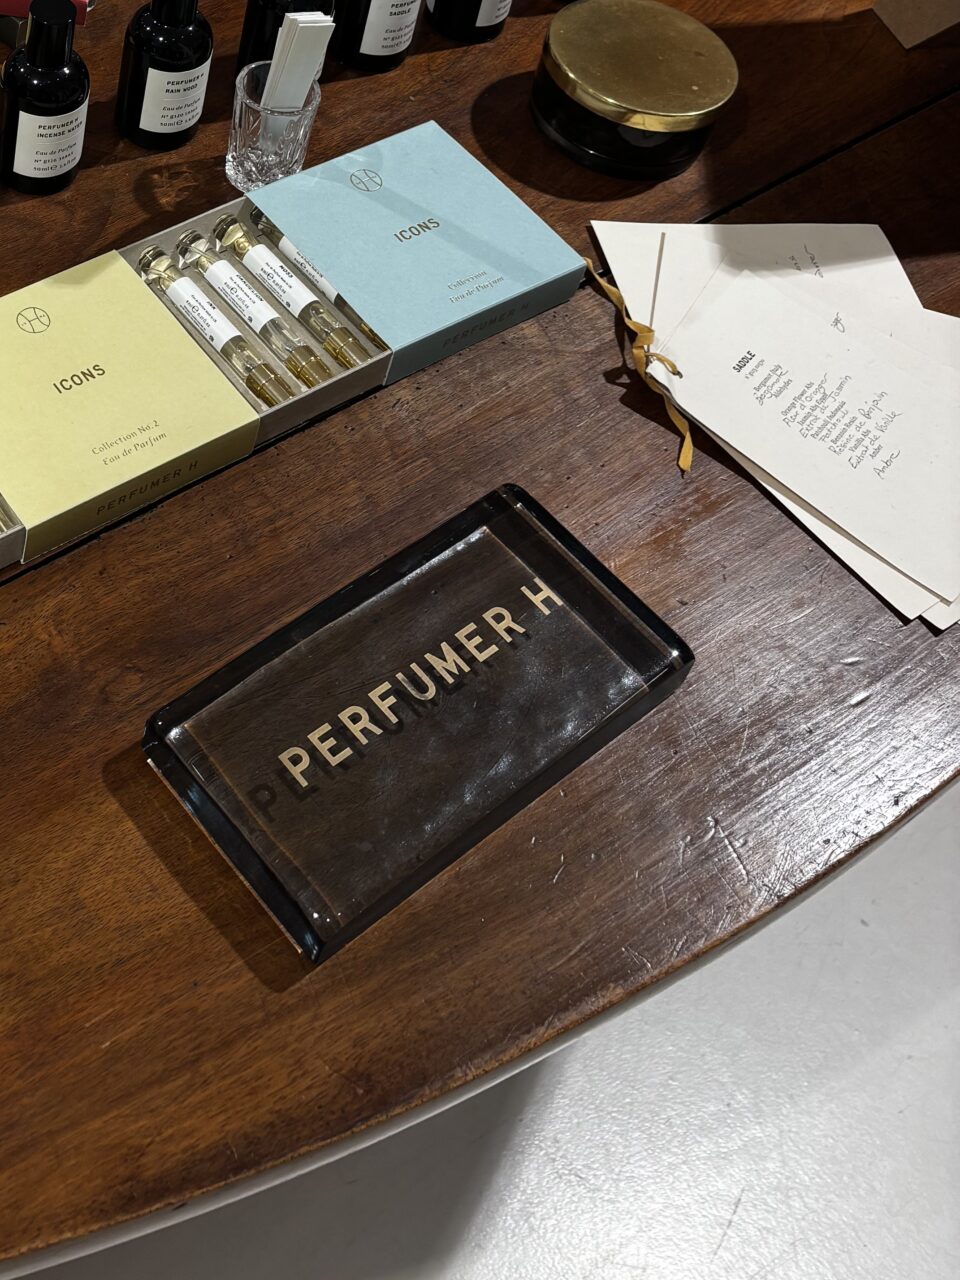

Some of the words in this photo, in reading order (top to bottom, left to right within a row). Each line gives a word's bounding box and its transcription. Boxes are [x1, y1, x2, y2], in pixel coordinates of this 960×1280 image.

[166, 75, 200, 86] PERFUMER
[182, 84, 198, 92] WOOD
[37, 130, 66, 138] INCENSE
[38, 120, 74, 130] PERFUMER
[393, 218, 440, 243] ICONS
[447, 270, 488, 292] Collection
[449, 294, 466, 304] Eau
[466, 288, 474, 298] de
[475, 276, 505, 292] Parfum
[442, 308, 516, 348] PERFUMER
[733, 351, 755, 372] SADDLE
[52, 364, 106, 394] ICONS
[781, 402, 796, 418] Orange
[793, 389, 807, 402] Flower
[92, 431, 138, 455] Collection
[102, 455, 121, 466] Eau
[122, 448, 132, 457] de
[134, 432, 168, 451] Parfum
[868, 435, 880, 446] de
[96, 468, 182, 516] PERFUMER
[189, 460, 199, 472] H
[278, 606, 526, 787] PERFUMER
[520, 577, 564, 616] H
